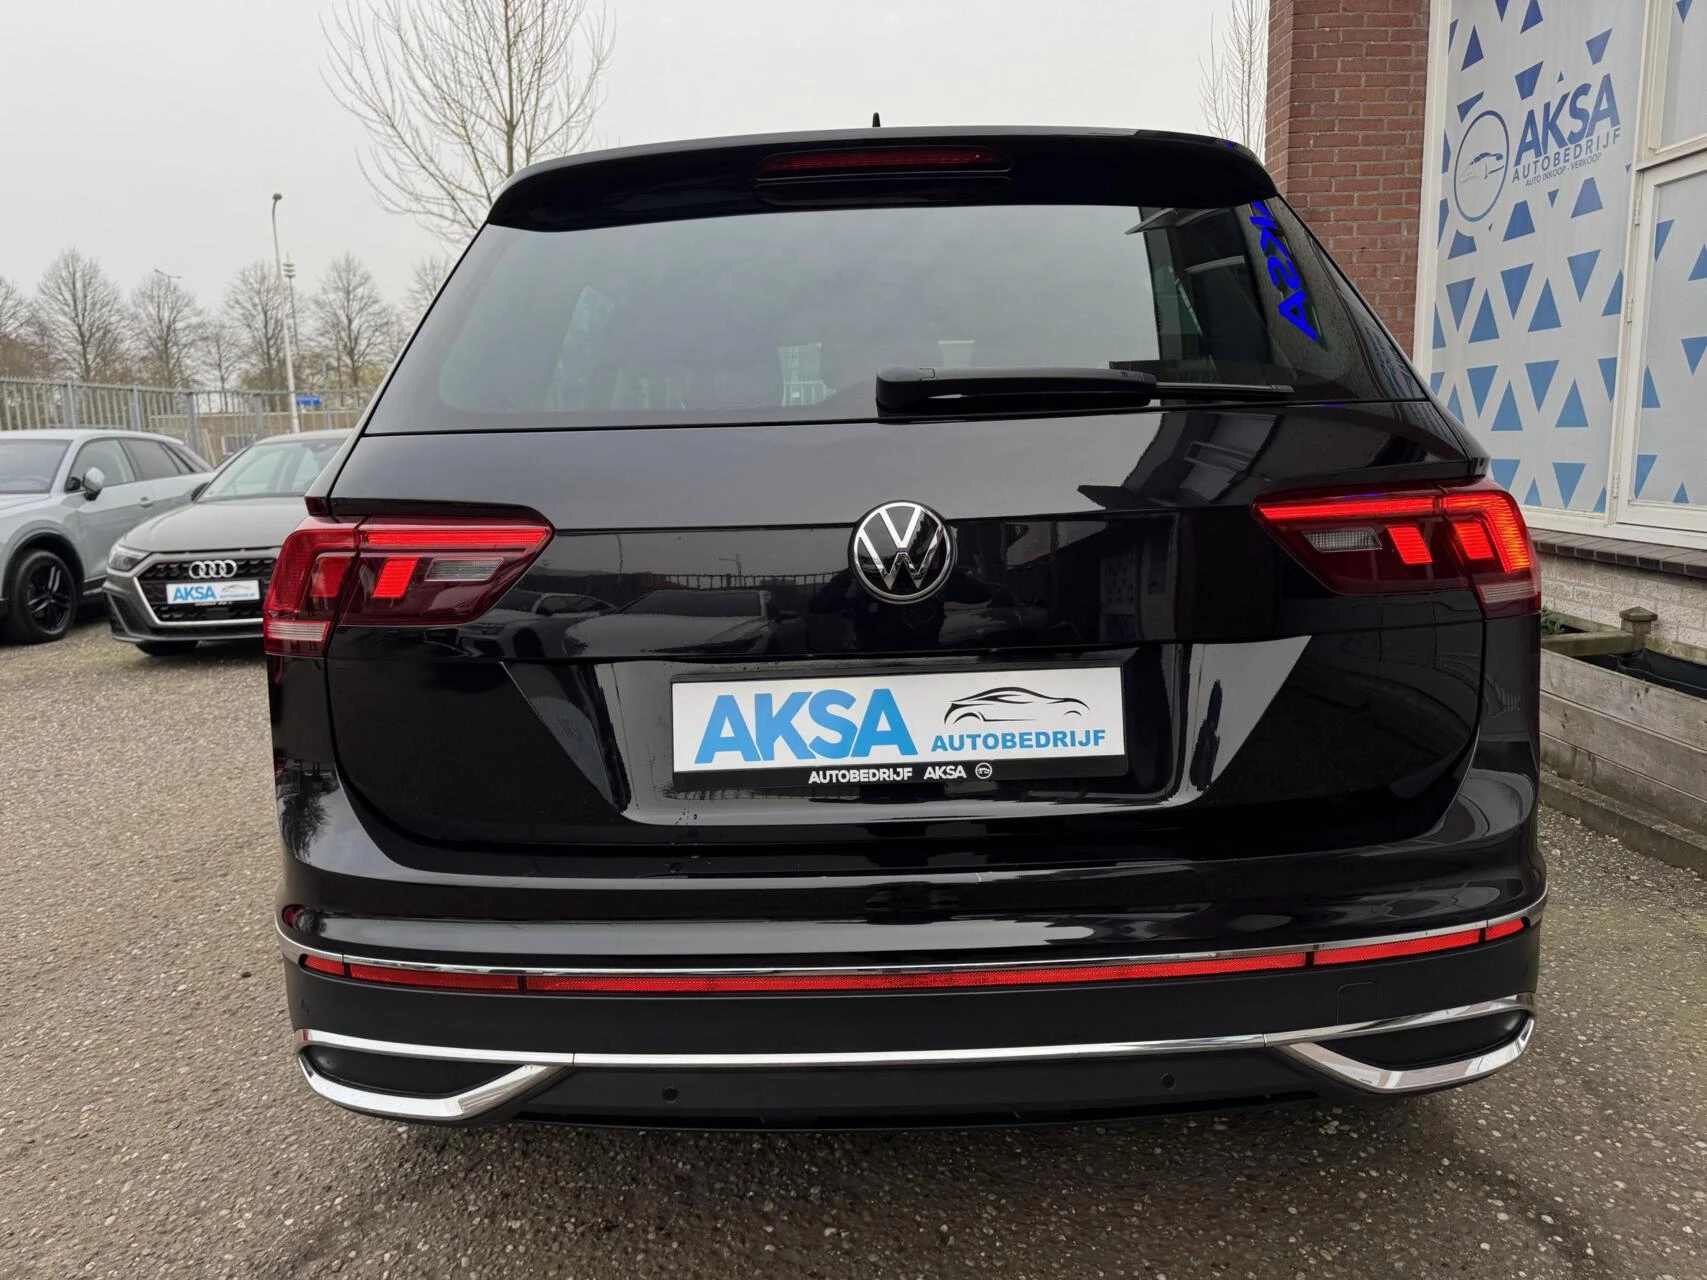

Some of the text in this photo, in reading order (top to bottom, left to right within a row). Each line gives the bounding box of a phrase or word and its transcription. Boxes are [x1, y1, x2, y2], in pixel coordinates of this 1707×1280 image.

[1514, 73, 1620, 167] AKSA
[1512, 127, 1621, 183] AUTOBEDRIJF
[1525, 174, 1541, 187] AUTO
[1542, 165, 1567, 181] INKOOP
[1571, 152, 1602, 170] VERKOOP
[173, 585, 217, 602] AKSA
[694, 688, 918, 764] AKSA
[930, 729, 1106, 752] AUTOBEDRIJF
[808, 765, 967, 784] AUTOBEDRIJF AKSA
